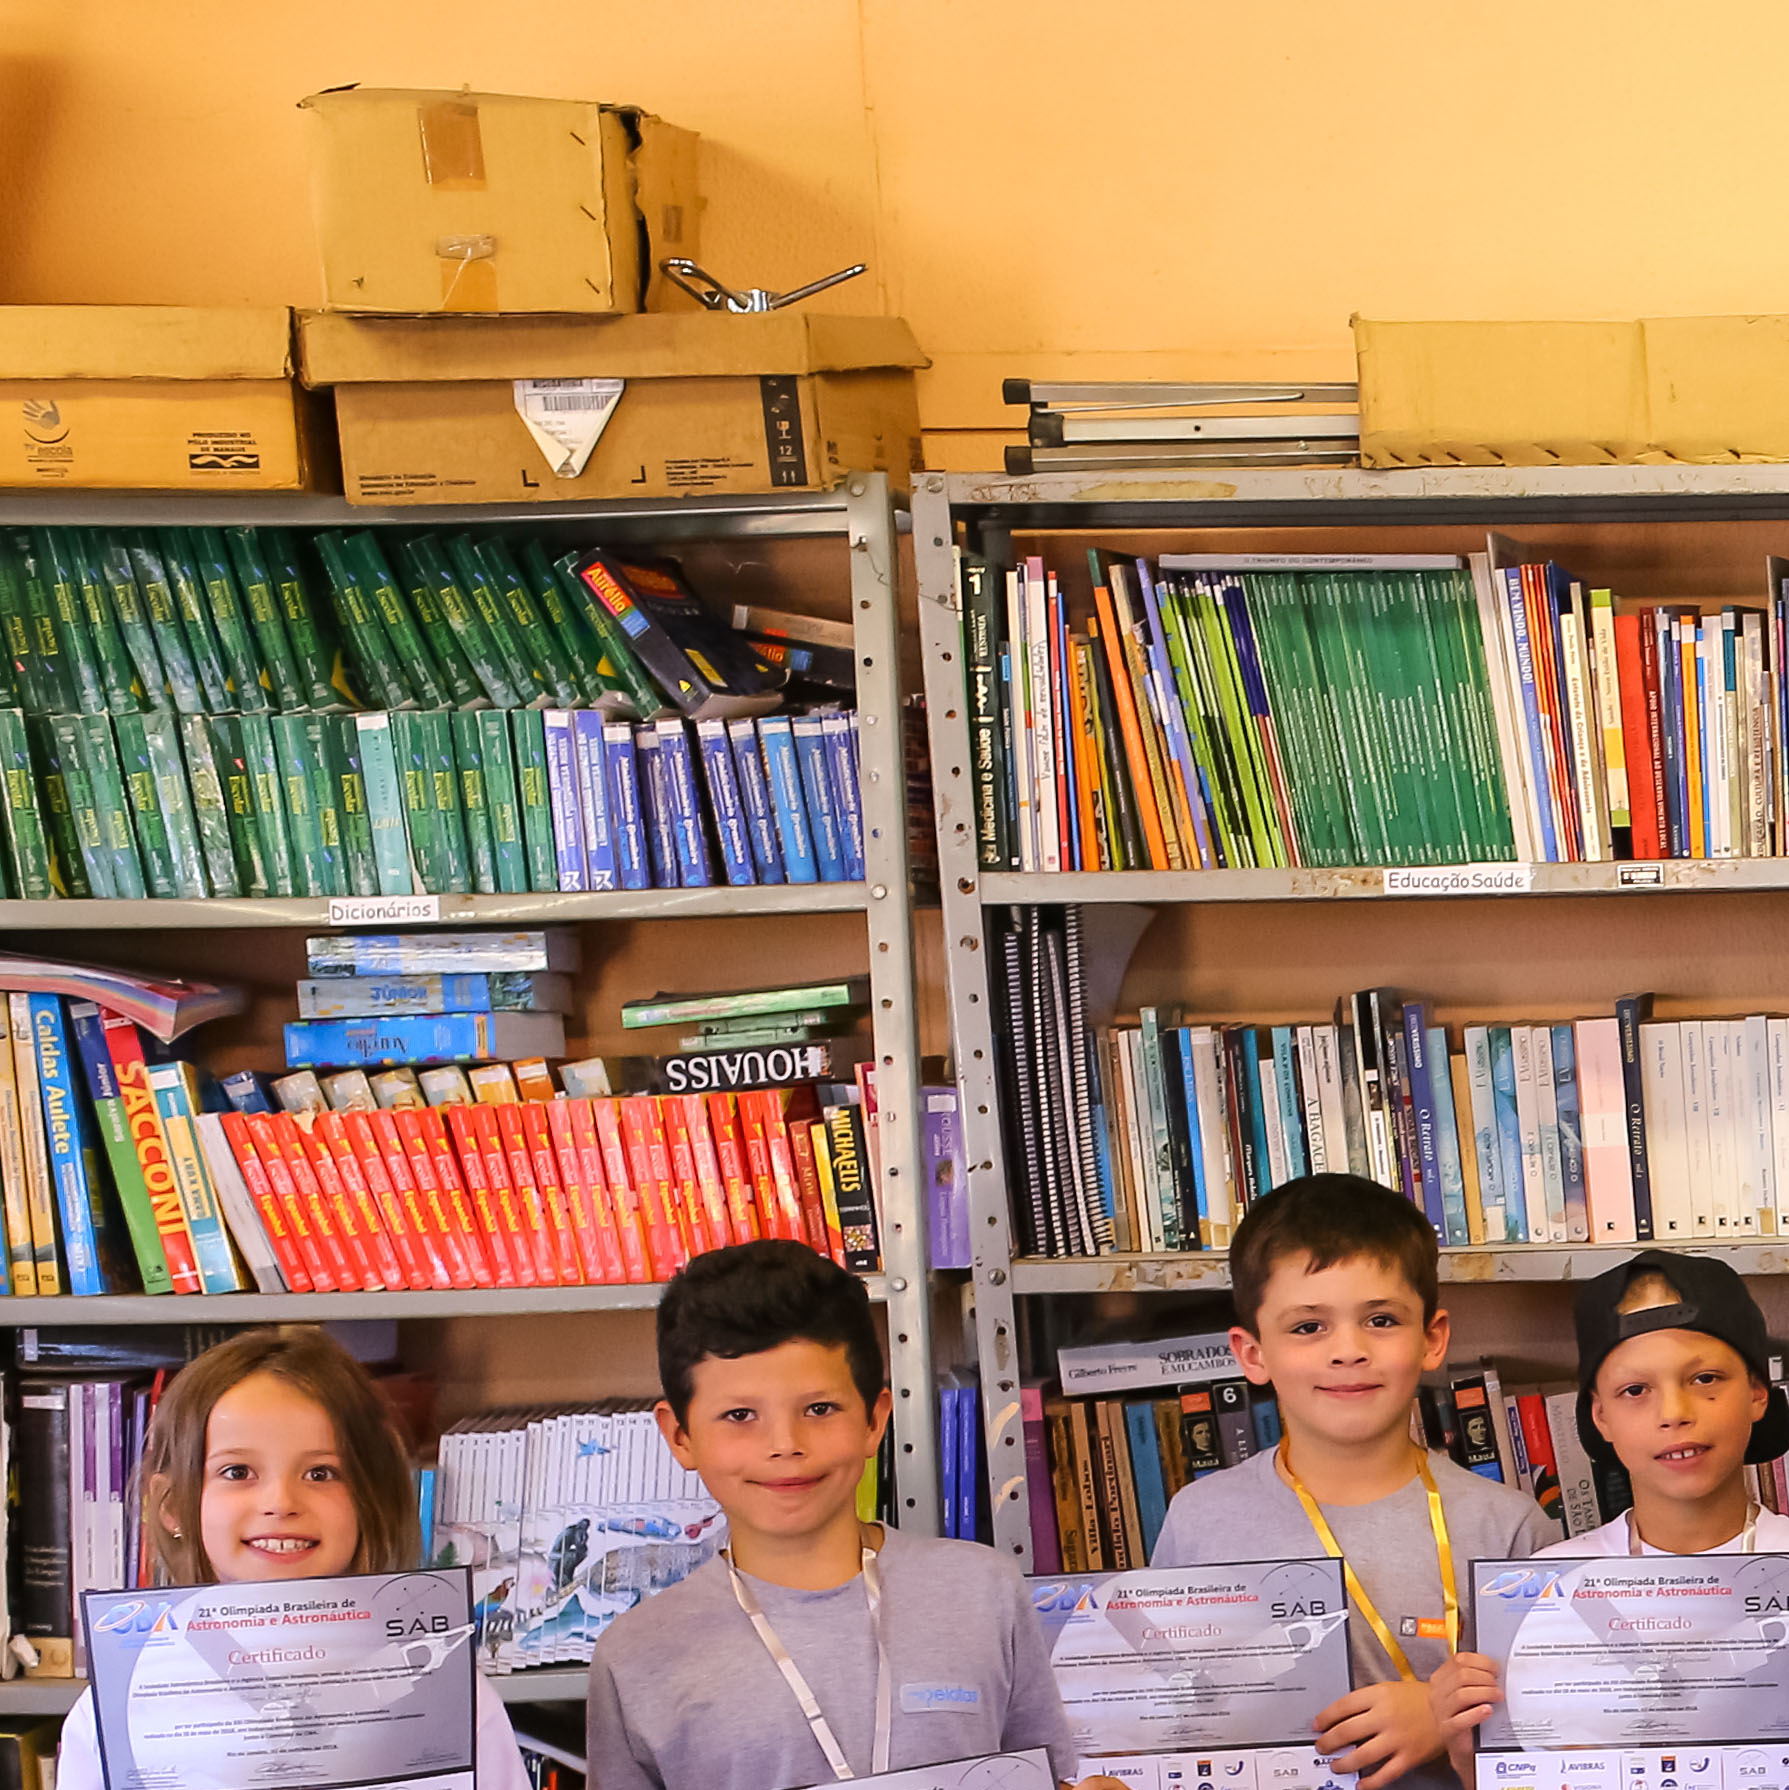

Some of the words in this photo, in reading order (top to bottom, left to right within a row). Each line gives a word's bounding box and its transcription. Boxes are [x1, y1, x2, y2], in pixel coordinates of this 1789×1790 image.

[587, 566, 628, 614] Aurélio
[1518, 640, 1533, 684] MUNDO!
[977, 728, 992, 770] Saúde
[981, 779, 997, 842] Medicina
[1388, 871, 1470, 891] Educação
[1471, 872, 1524, 890] Saúde
[331, 902, 431, 921] Dicionários
[35, 1009, 61, 1080] Caldas
[665, 1046, 823, 1092] HOUAISS
[97, 1063, 113, 1097] Júnior
[44, 1084, 71, 1155] Aulete
[116, 1059, 184, 1234] SACCONI
[827, 1109, 861, 1193] MICHAELIS
[1158, 1344, 1233, 1364] SOBRADOS
[1068, 1366, 1107, 1379] Gilberto
[1169, 1358, 1236, 1373] MUCAMBOS
[1222, 1387, 1237, 1404] 6
[1135, 1586, 1185, 1599] Olimpíada
[1188, 1585, 1232, 1595] Brasileira
[1572, 1588, 1642, 1599] Astronomia
[1656, 1584, 1732, 1597] Astronáutica
[1603, 1576, 1655, 1588] Olimpíada
[1658, 1576, 1701, 1586] Brasileira
[220, 1603, 280, 1618] Olimpíada
[283, 1601, 338, 1613] Brasileira
[1107, 1598, 1173, 1611] Astronomia
[1187, 1593, 1259, 1607] Astronáutica
[1271, 1600, 1326, 1618] SAB
[187, 1616, 266, 1632] Astronomia
[282, 1609, 371, 1625] Astronáutica
[386, 1615, 449, 1637] SAB
[1608, 1617, 1692, 1631] Certificado
[1142, 1625, 1222, 1641] Certificado
[228, 1646, 326, 1665] Certificado
